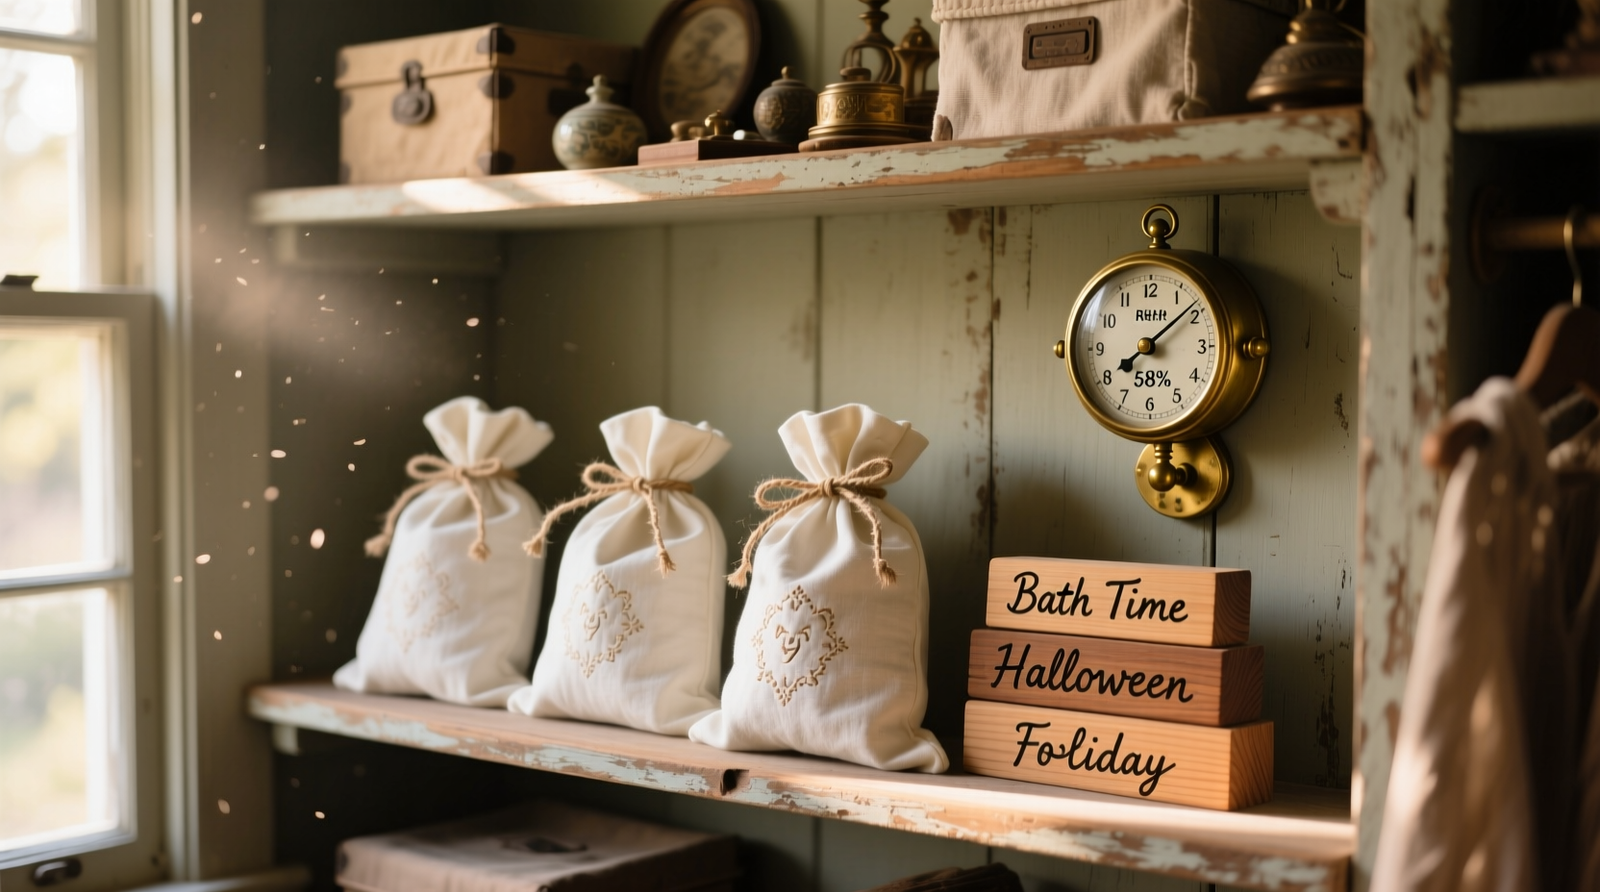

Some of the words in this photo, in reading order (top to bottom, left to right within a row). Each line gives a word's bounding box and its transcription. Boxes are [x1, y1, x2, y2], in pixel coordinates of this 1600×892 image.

[1144, 282, 1158, 298] 12
[1175, 290, 1179, 305] 1
[1120, 292, 1130, 307] 11
[1103, 313, 1117, 328] 10
[1189, 309, 1200, 324] 2
[1095, 342, 1105, 356] 9
[1197, 339, 1207, 354] 3
[1103, 369, 1112, 385] 8
[1134, 370, 1171, 387] 58%
[1189, 367, 1200, 383] 4
[1120, 389, 1129, 404] 7
[1172, 388, 1182, 403] 5
[1145, 397, 1155, 411] 6
[1006, 571, 1093, 617] Bath
[1105, 577, 1188, 623] Time
[990, 642, 1194, 703] Halloween
